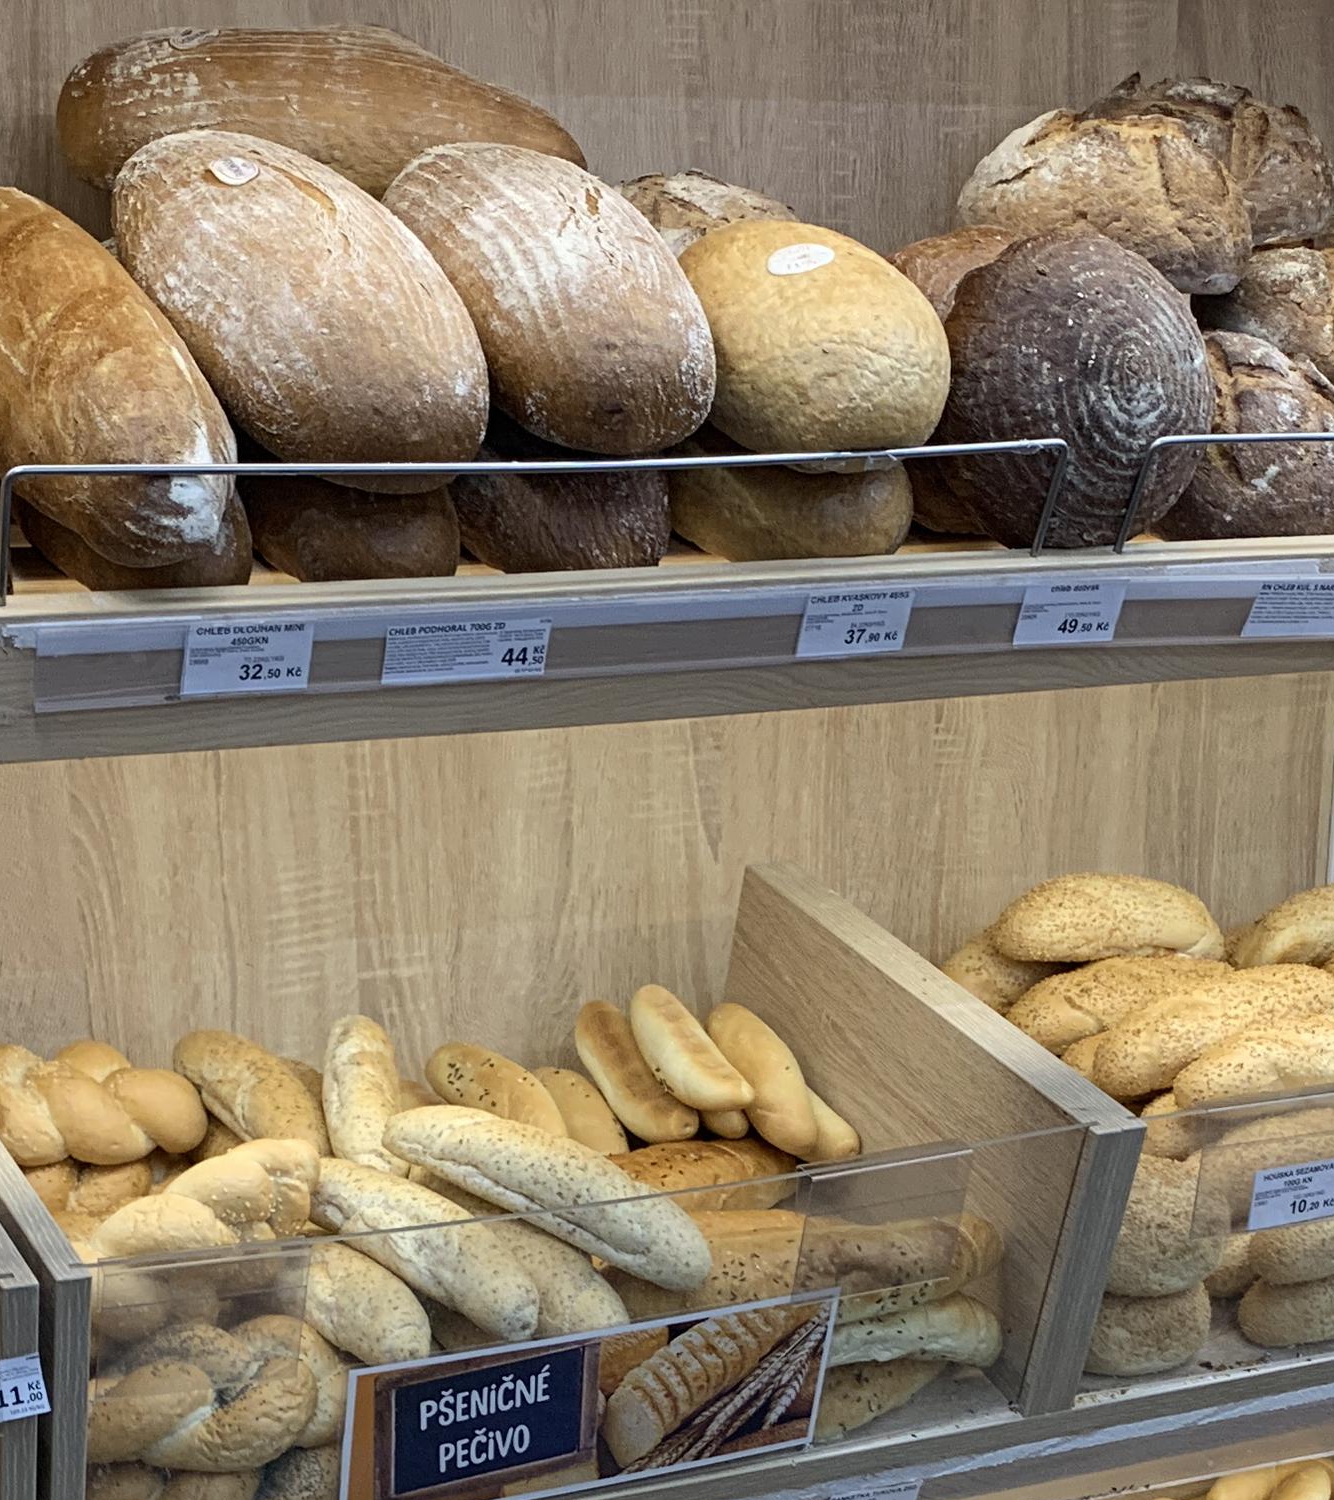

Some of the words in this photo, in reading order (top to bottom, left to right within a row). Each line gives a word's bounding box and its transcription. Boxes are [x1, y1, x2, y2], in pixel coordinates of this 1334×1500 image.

[196, 626, 231, 636] CHLEB
[286, 667, 302, 677] Kč
[28, 1380, 42, 1391] Kč
